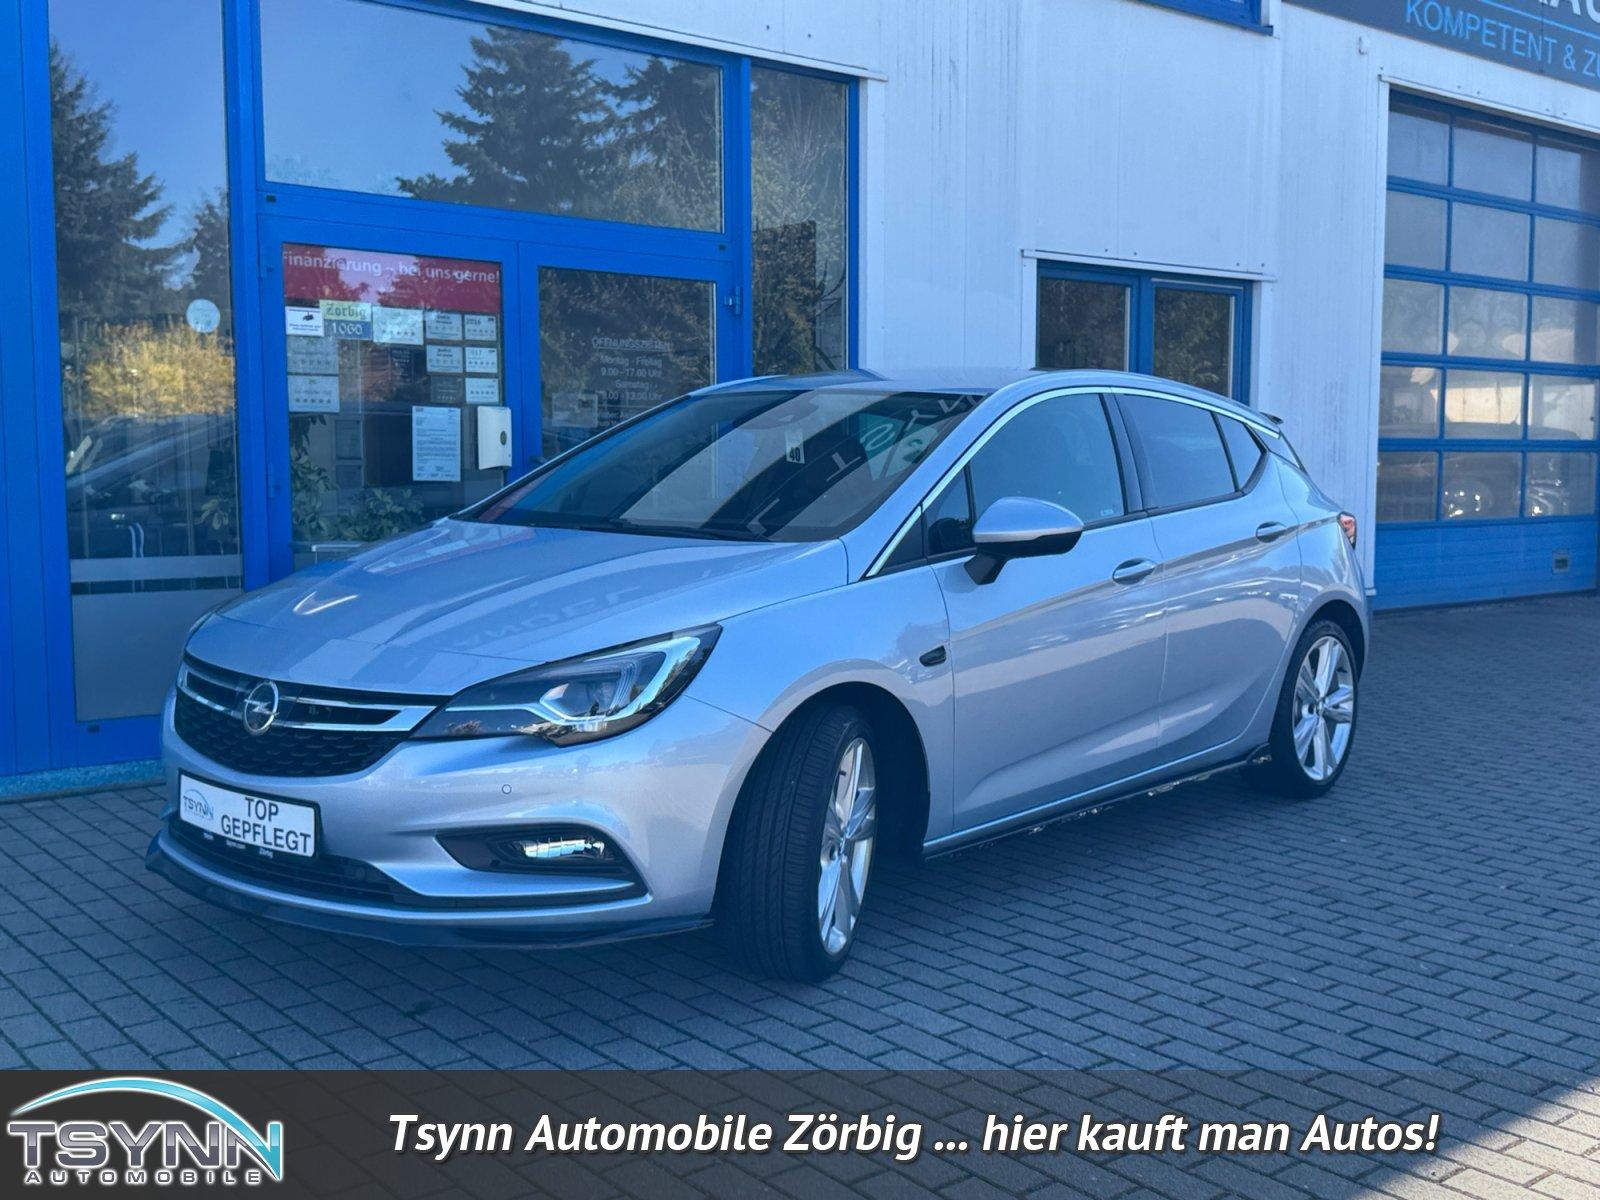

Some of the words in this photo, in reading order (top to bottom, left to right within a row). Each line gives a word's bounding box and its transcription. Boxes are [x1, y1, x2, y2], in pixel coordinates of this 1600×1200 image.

[1405, 0, 1557, 64] KOMPETENT
[1563, 43, 1577, 72] &
[282, 250, 382, 277] Finanzierung
[399, 261, 421, 277] bei
[425, 267, 451, 279] uns
[455, 270, 500, 284] gerne!
[183, 795, 215, 820] TSYNN
[245, 797, 279, 822] TOP
[221, 814, 311, 854] GEPFLEGT
